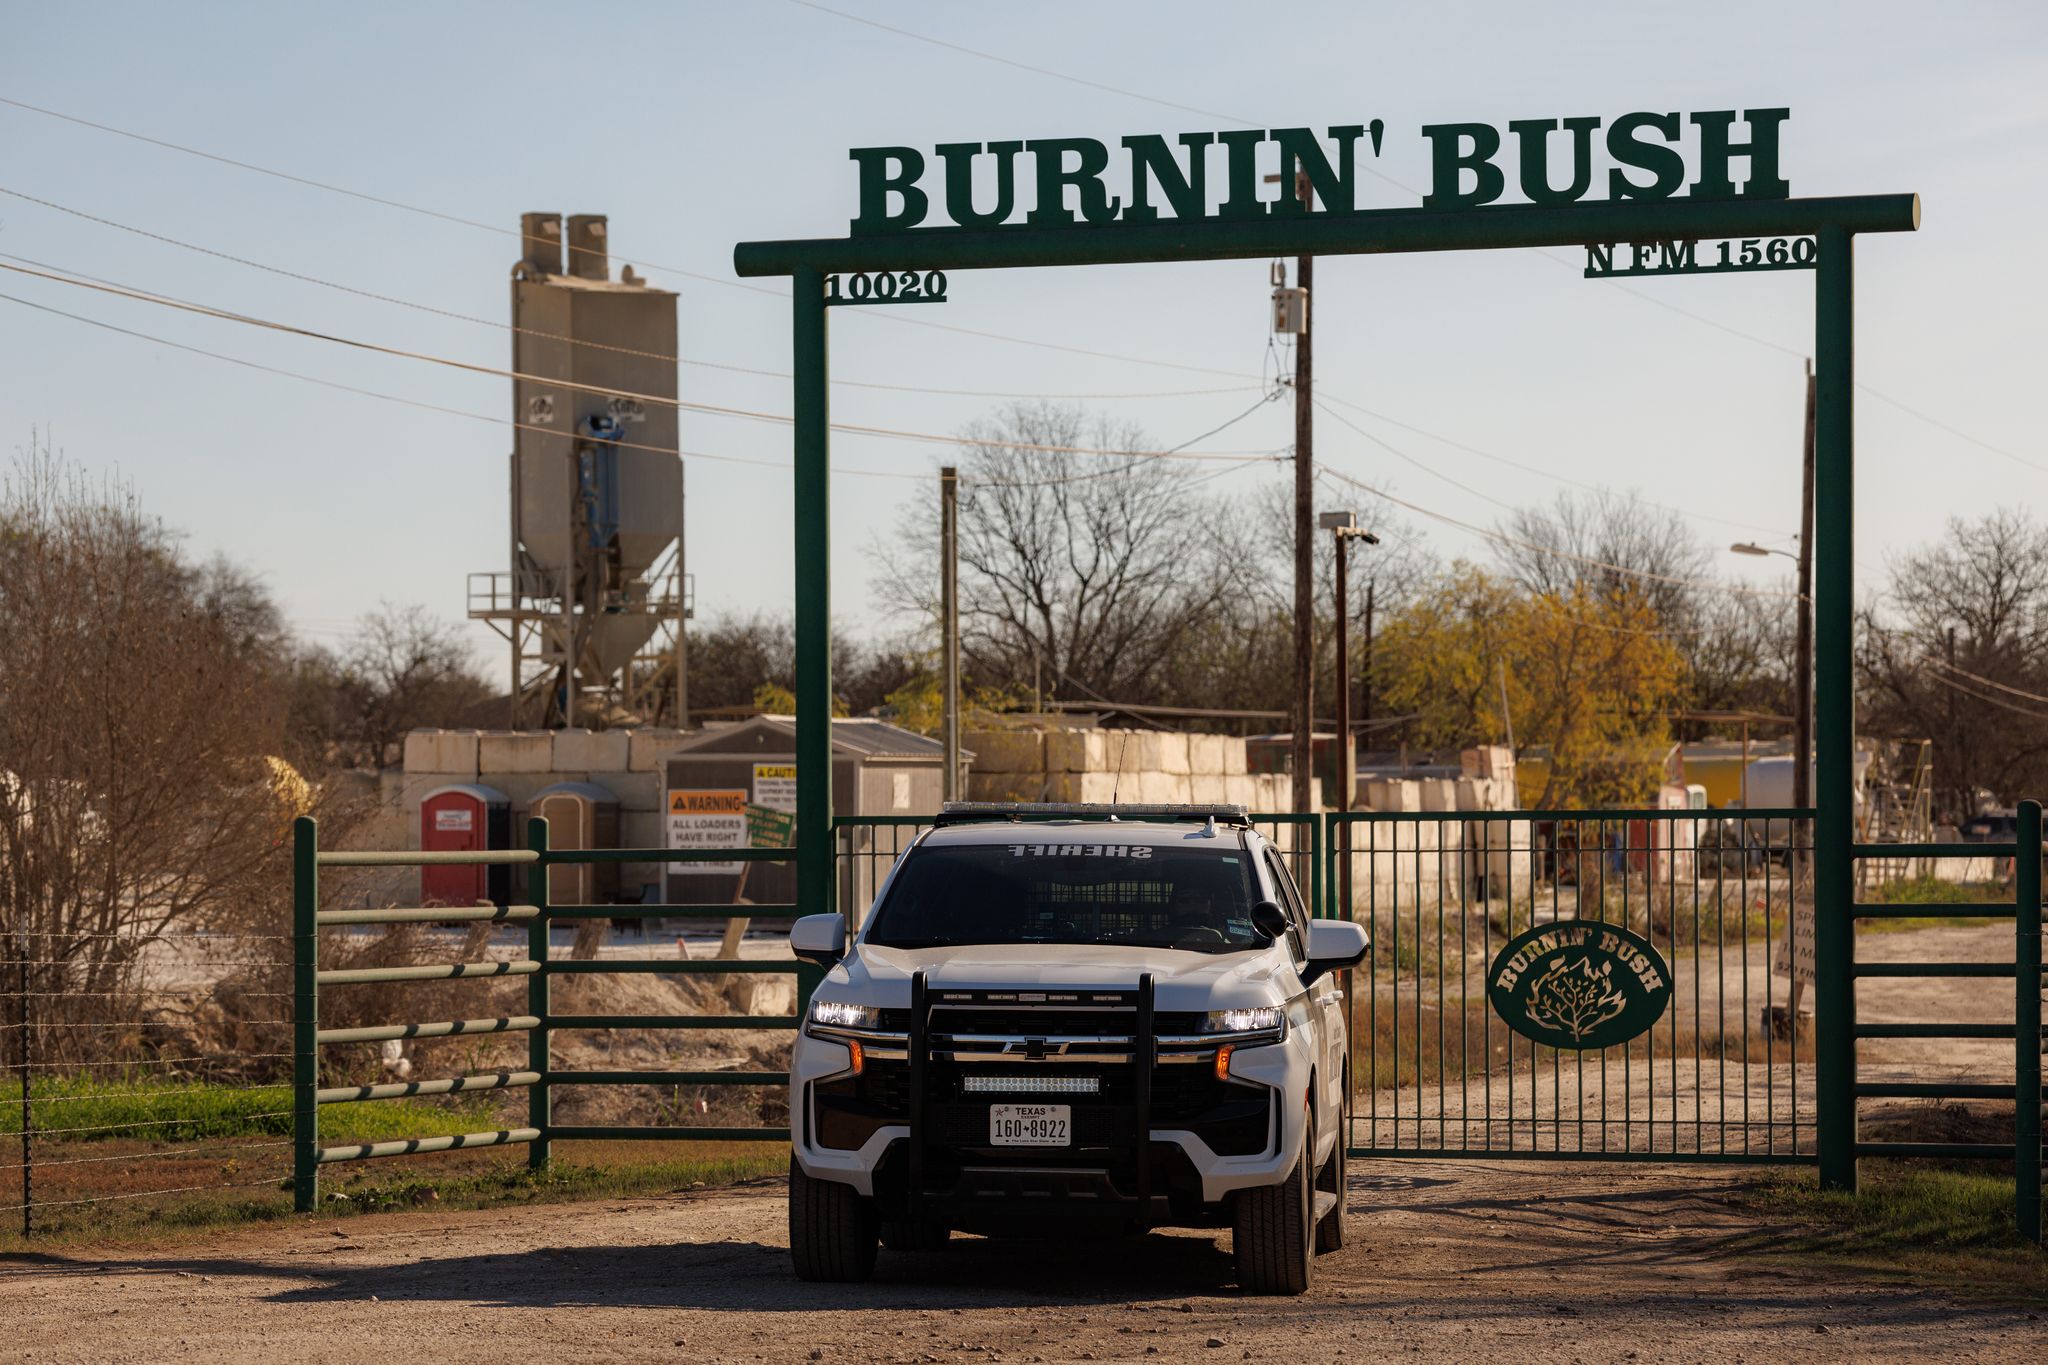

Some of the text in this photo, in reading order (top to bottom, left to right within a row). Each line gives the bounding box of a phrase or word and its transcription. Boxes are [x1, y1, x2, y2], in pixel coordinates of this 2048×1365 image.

[849, 107, 1790, 238] BURNIN' BUSH
[1584, 237, 1817, 272] N FM 1560
[825, 269, 947, 300] 10020
[687, 796, 741, 811] WARNING
[672, 819, 691, 829] ALL
[694, 819, 741, 829] LOADERS
[676, 832, 738, 842] HAVE RIGHT
[1495, 927, 1664, 993] BURNIN' BUSH
[1015, 1107, 1046, 1116] TEXAS
[995, 1119, 1066, 1138] 160 8922
